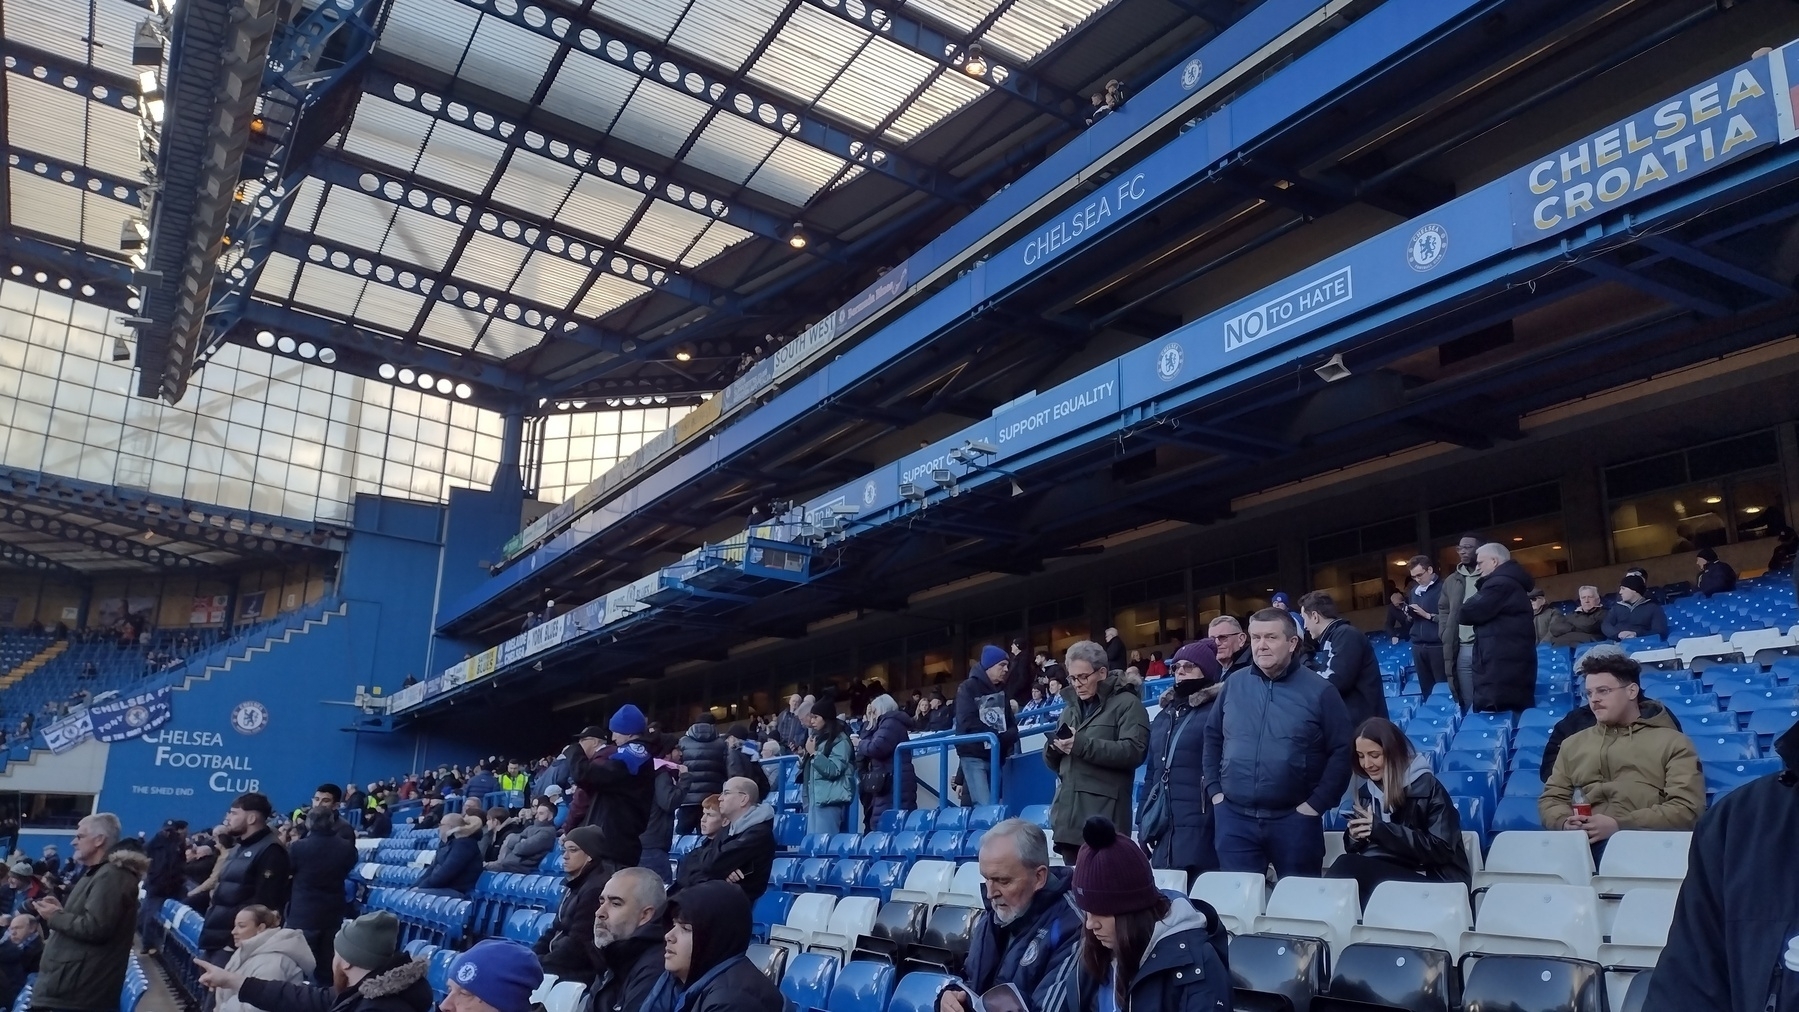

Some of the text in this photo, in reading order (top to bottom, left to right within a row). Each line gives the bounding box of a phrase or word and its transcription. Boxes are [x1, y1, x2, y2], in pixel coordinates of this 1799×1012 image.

[1528, 68, 1766, 195] CHELSEA
[1533, 113, 1758, 230] CROATIA
[1023, 172, 1146, 266] CHELSEA FC
[1412, 225, 1440, 242] CHELSEA
[1226, 276, 1346, 349] NO TO HATE
[775, 334, 807, 368] SOUTH
[808, 313, 836, 345] WEST
[999, 380, 1115, 444] SUPPORT EQUALITY
[902, 456, 945, 485] SUPPORT
[544, 619, 560, 641] BLUES
[91, 692, 155, 715] CHELSEA
[98, 715, 123, 733] TONY
[154, 746, 253, 771] FOOTBALL
[132, 785, 194, 796] THE SHED END
[209, 771, 260, 793] CLUB
